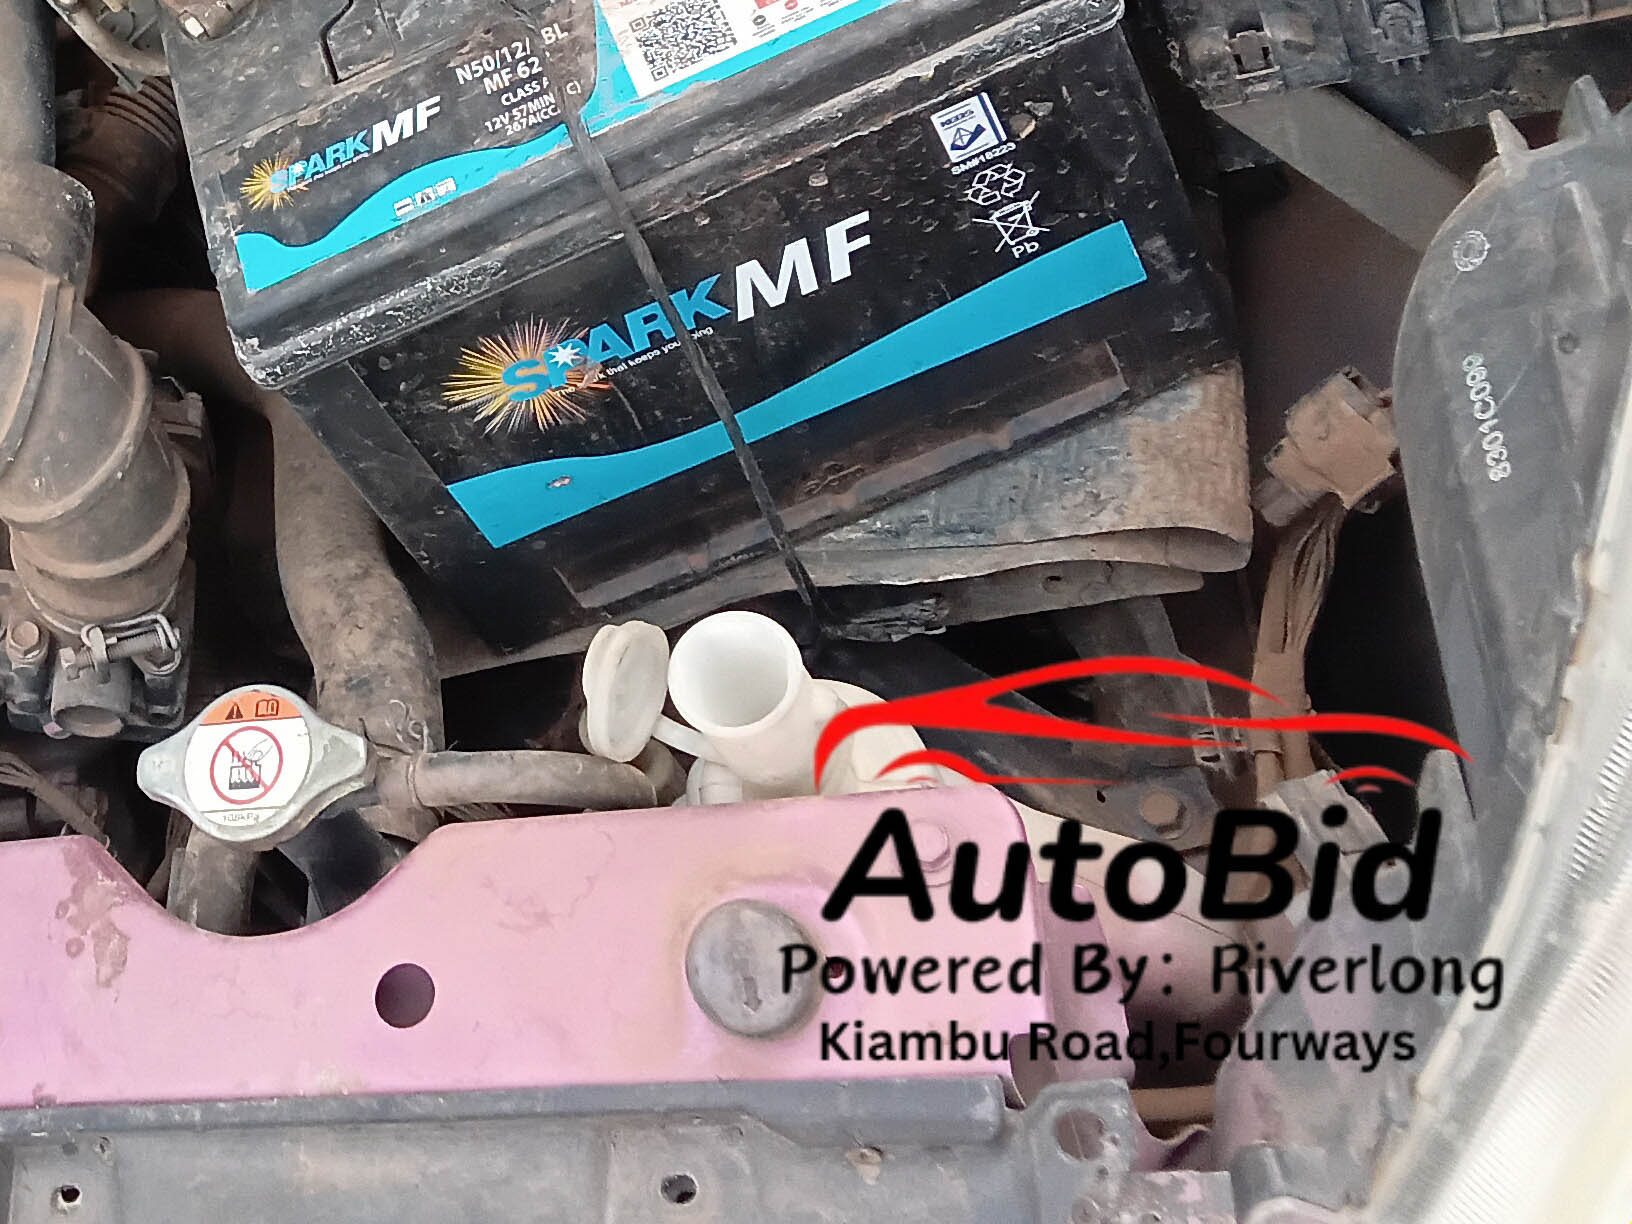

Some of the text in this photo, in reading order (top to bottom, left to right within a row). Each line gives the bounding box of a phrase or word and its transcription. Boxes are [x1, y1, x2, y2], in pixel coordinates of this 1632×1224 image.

[482, 56, 543, 95] MF 62
[500, 80, 541, 106] CLASS
[1011, 240, 1040, 259] Pb
